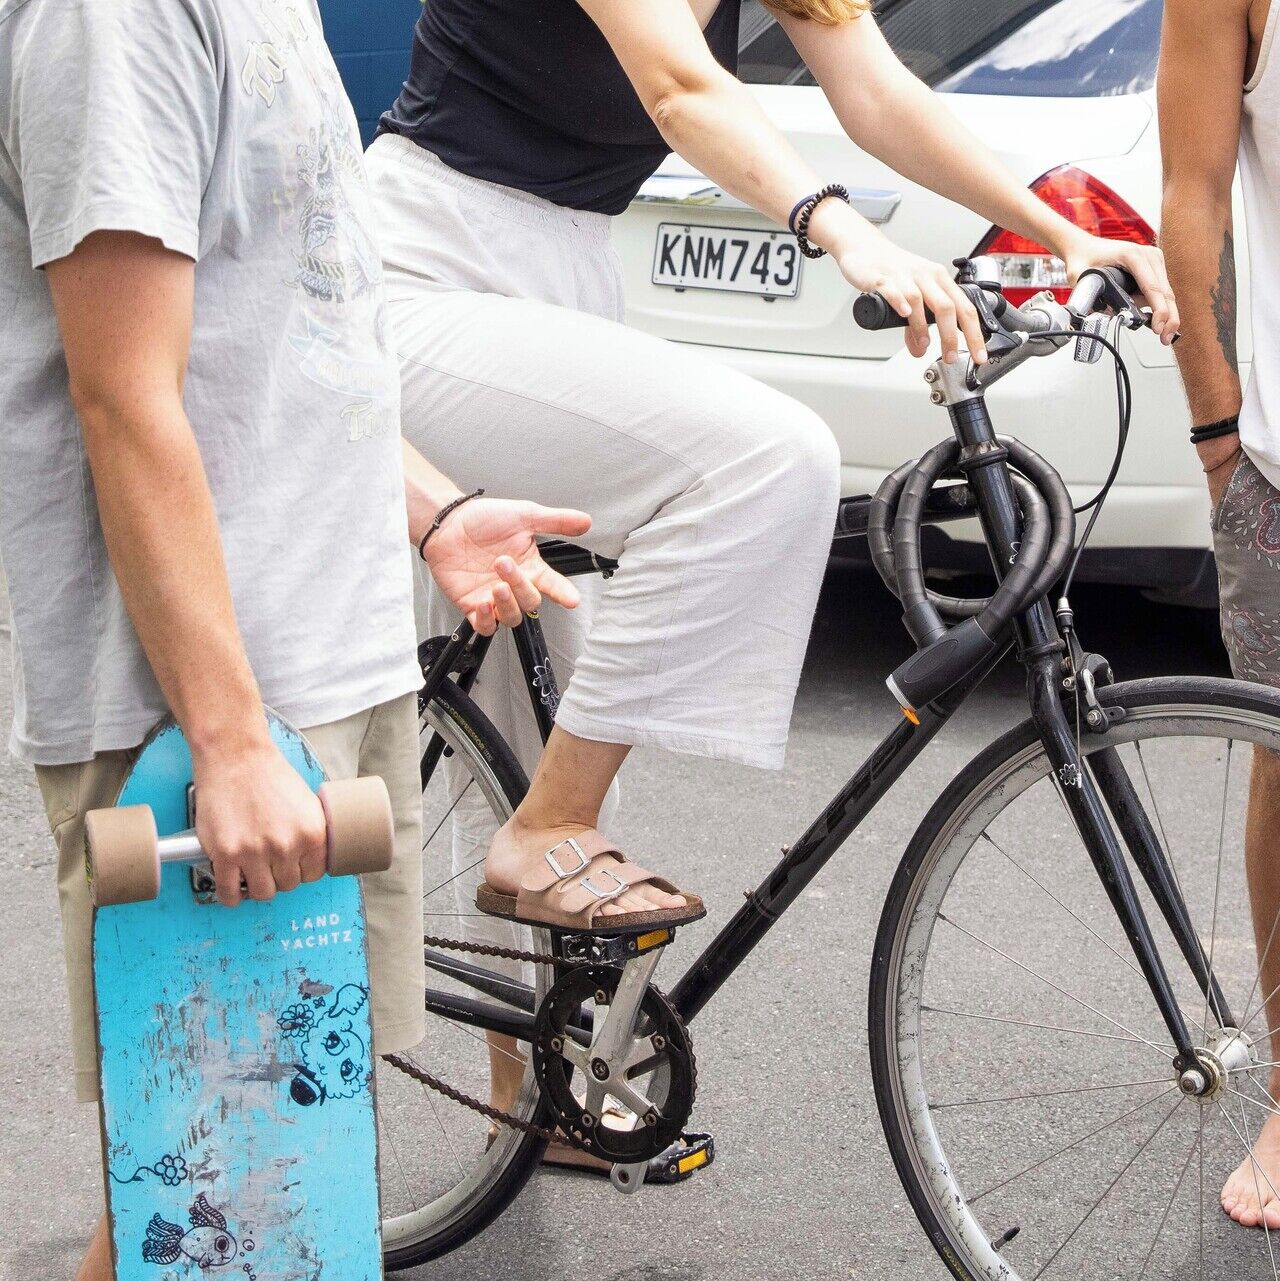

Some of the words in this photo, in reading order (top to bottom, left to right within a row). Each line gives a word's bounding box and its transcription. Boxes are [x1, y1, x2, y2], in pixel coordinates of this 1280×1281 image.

[659, 233, 797, 287] KNM743
[291, 913, 340, 931] LAND
[281, 930, 352, 951] YACHTZ
